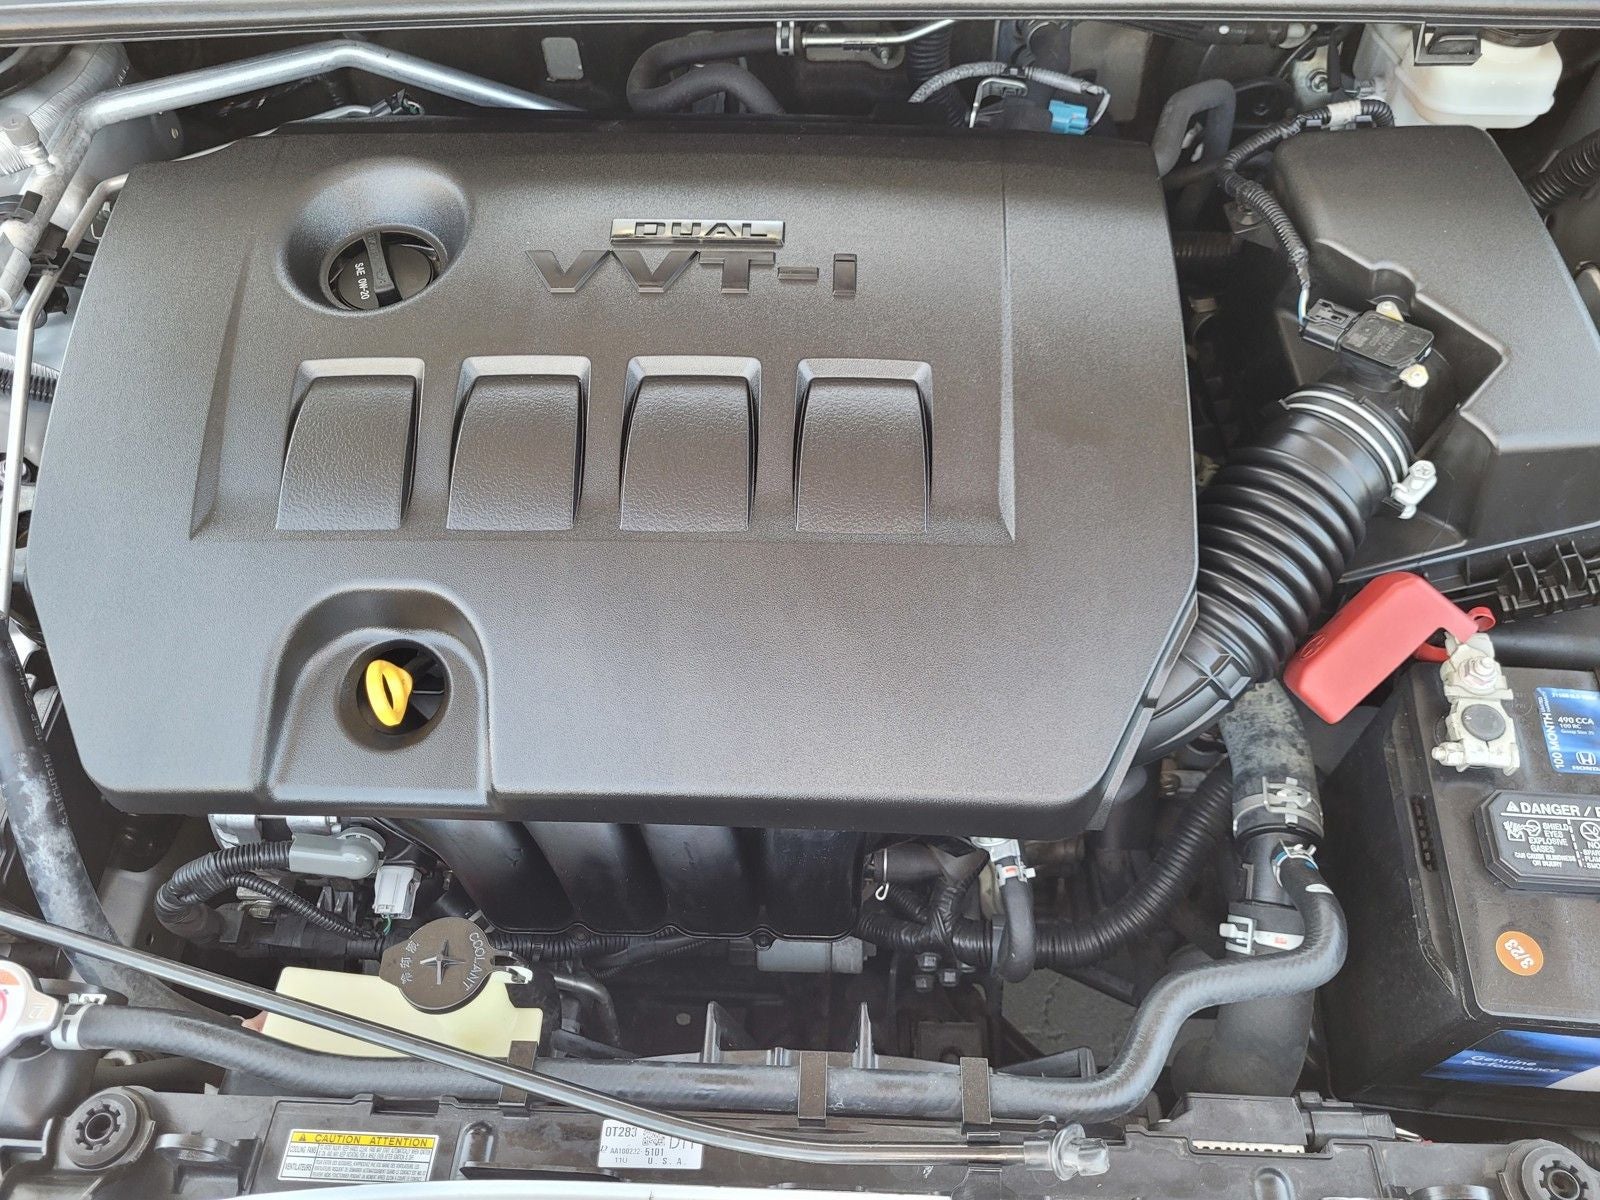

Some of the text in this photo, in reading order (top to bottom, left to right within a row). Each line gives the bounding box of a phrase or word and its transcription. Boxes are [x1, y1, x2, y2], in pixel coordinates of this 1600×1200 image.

[634, 221, 769, 238] DUAL
[354, 262, 370, 300] SAE 0W-20
[1557, 716, 1595, 725] 490 CCA
[1541, 712, 1565, 769] 100 MONTH
[1519, 801, 1581, 817] DANGER
[1542, 822, 1569, 831] SHIELD
[1543, 830, 1564, 839] EYES
[1527, 836, 1569, 846] EXPLOSIVE
[1529, 844, 1556, 854] GASES
[1582, 848, 1600, 856] SPAR
[1584, 855, 1600, 863] FLAM
[1504, 938, 1535, 969] 3/23
[462, 932, 485, 991] COOLANT
[1462, 1059, 1561, 1073] Performance
[1470, 1055, 1537, 1066] Genuine
[314, 1134, 428, 1147] CAUTION ATTENTION
[644, 1147, 664, 1157] 5101
